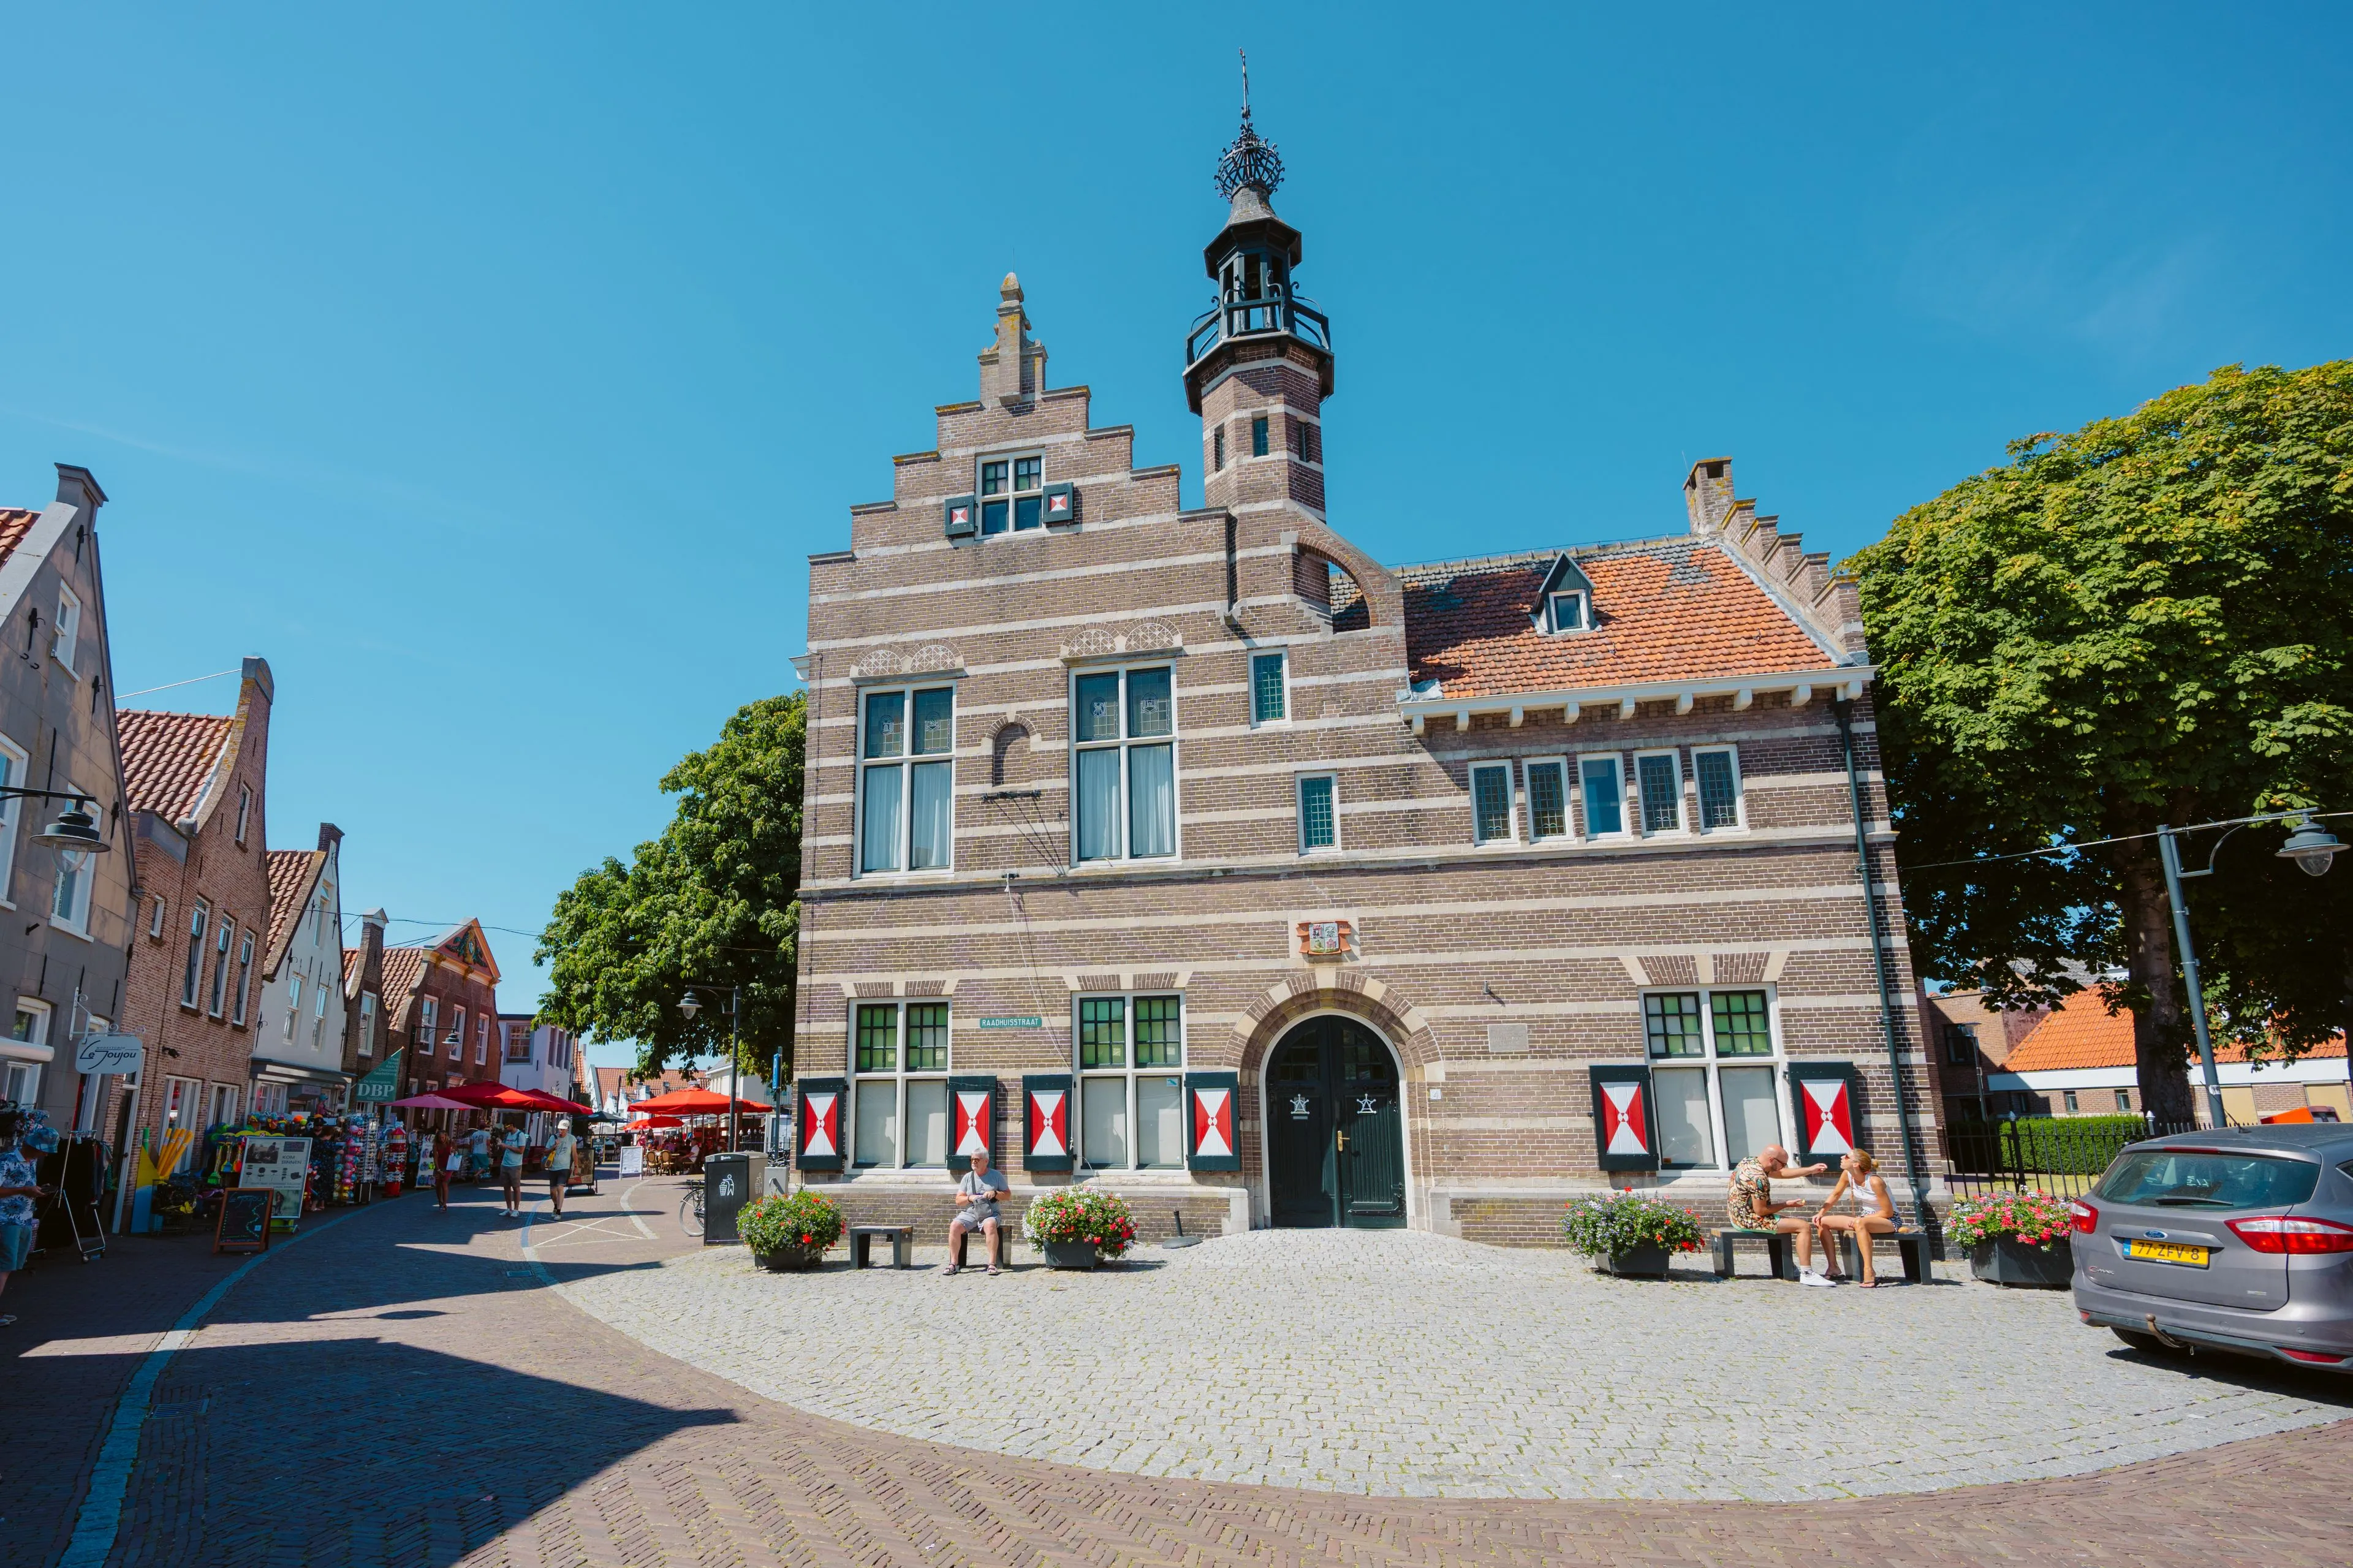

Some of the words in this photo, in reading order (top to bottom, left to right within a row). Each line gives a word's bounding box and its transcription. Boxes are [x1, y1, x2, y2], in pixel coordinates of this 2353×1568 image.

[982, 1018, 1039, 1026] RAADHUISSTRAAT
[79, 1040, 100, 1059] Le
[87, 1050, 137, 1070] Joujou
[357, 1083, 395, 1097] DBP
[2137, 1242, 2199, 1260] 77-ZFV-8
